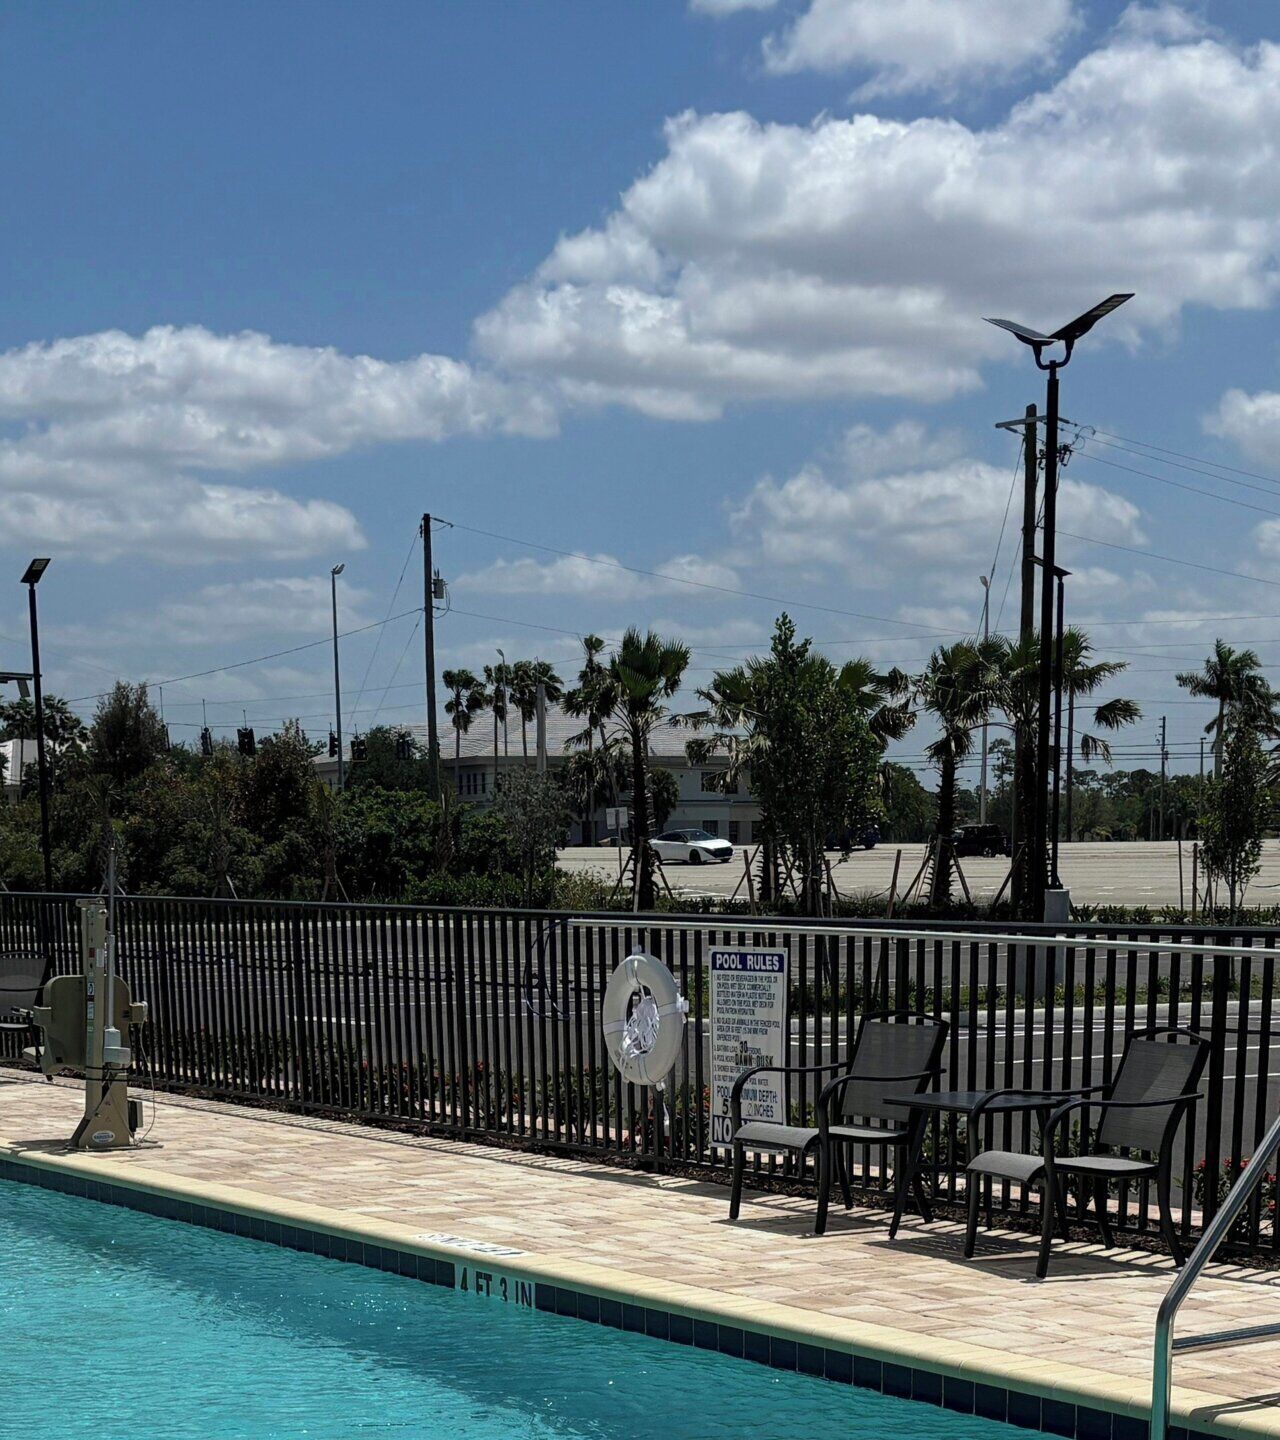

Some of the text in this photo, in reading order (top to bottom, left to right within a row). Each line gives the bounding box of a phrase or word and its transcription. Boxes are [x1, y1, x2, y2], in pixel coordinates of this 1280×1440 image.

[716, 954, 779, 970] POOL RULES
[739, 1041, 748, 1053] 30
[735, 1054, 752, 1066] DAWN
[756, 1055, 773, 1067] DUSK
[717, 1085, 732, 1098] POOL
[722, 1099, 729, 1115] 5
[754, 1103, 774, 1118] INCHES
[714, 1117, 732, 1142] NO
[460, 1267, 532, 1308] 4 FT 3 IN
